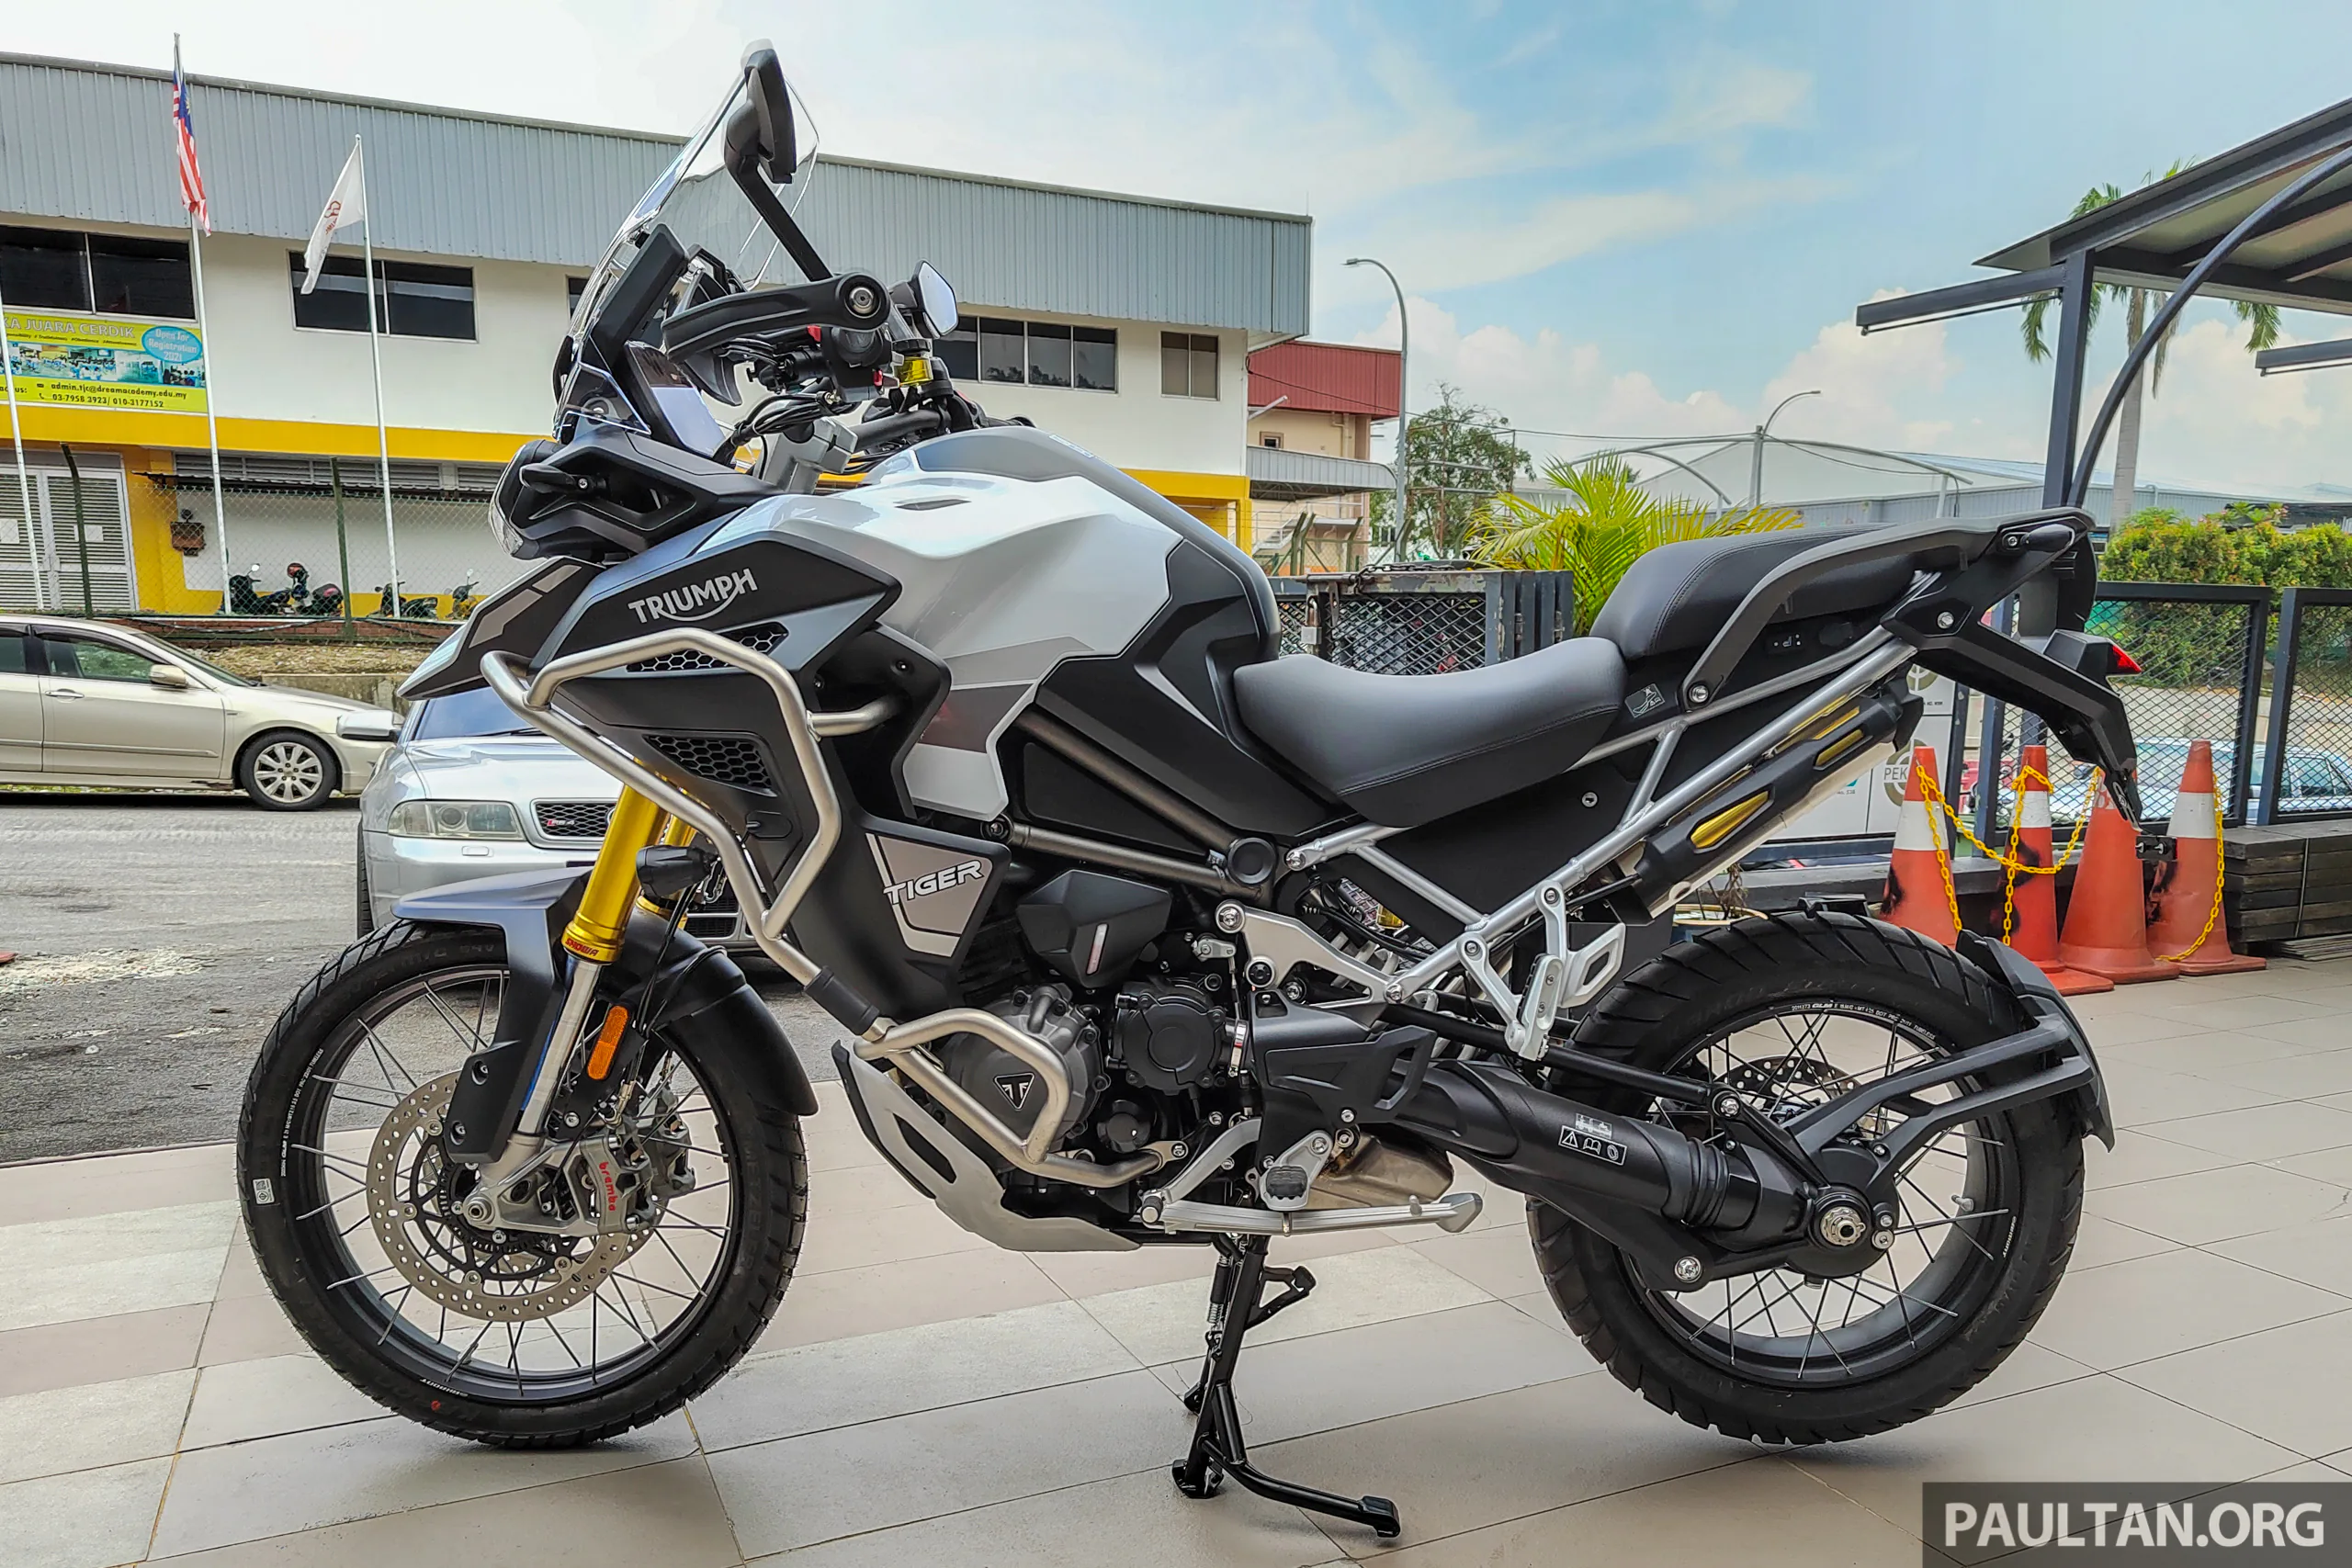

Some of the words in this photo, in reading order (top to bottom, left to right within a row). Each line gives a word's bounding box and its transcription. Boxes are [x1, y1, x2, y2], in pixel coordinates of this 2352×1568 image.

[26, 319, 75, 333] JUARA
[79, 323, 135, 338] CERDIK
[155, 328, 175, 340] Open
[148, 338, 198, 354] Registration
[51, 382, 187, 400] admin.tjc@dreamacademy.edu.my
[52, 393, 85, 402] 03-7958
[112, 398, 164, 408] 010-3177152
[628, 568, 758, 624] TRIUMPH
[883, 860, 985, 906] TIGER
[565, 937, 599, 957] SHOWA
[1913, 1024, 1937, 1040] TUBELESS
